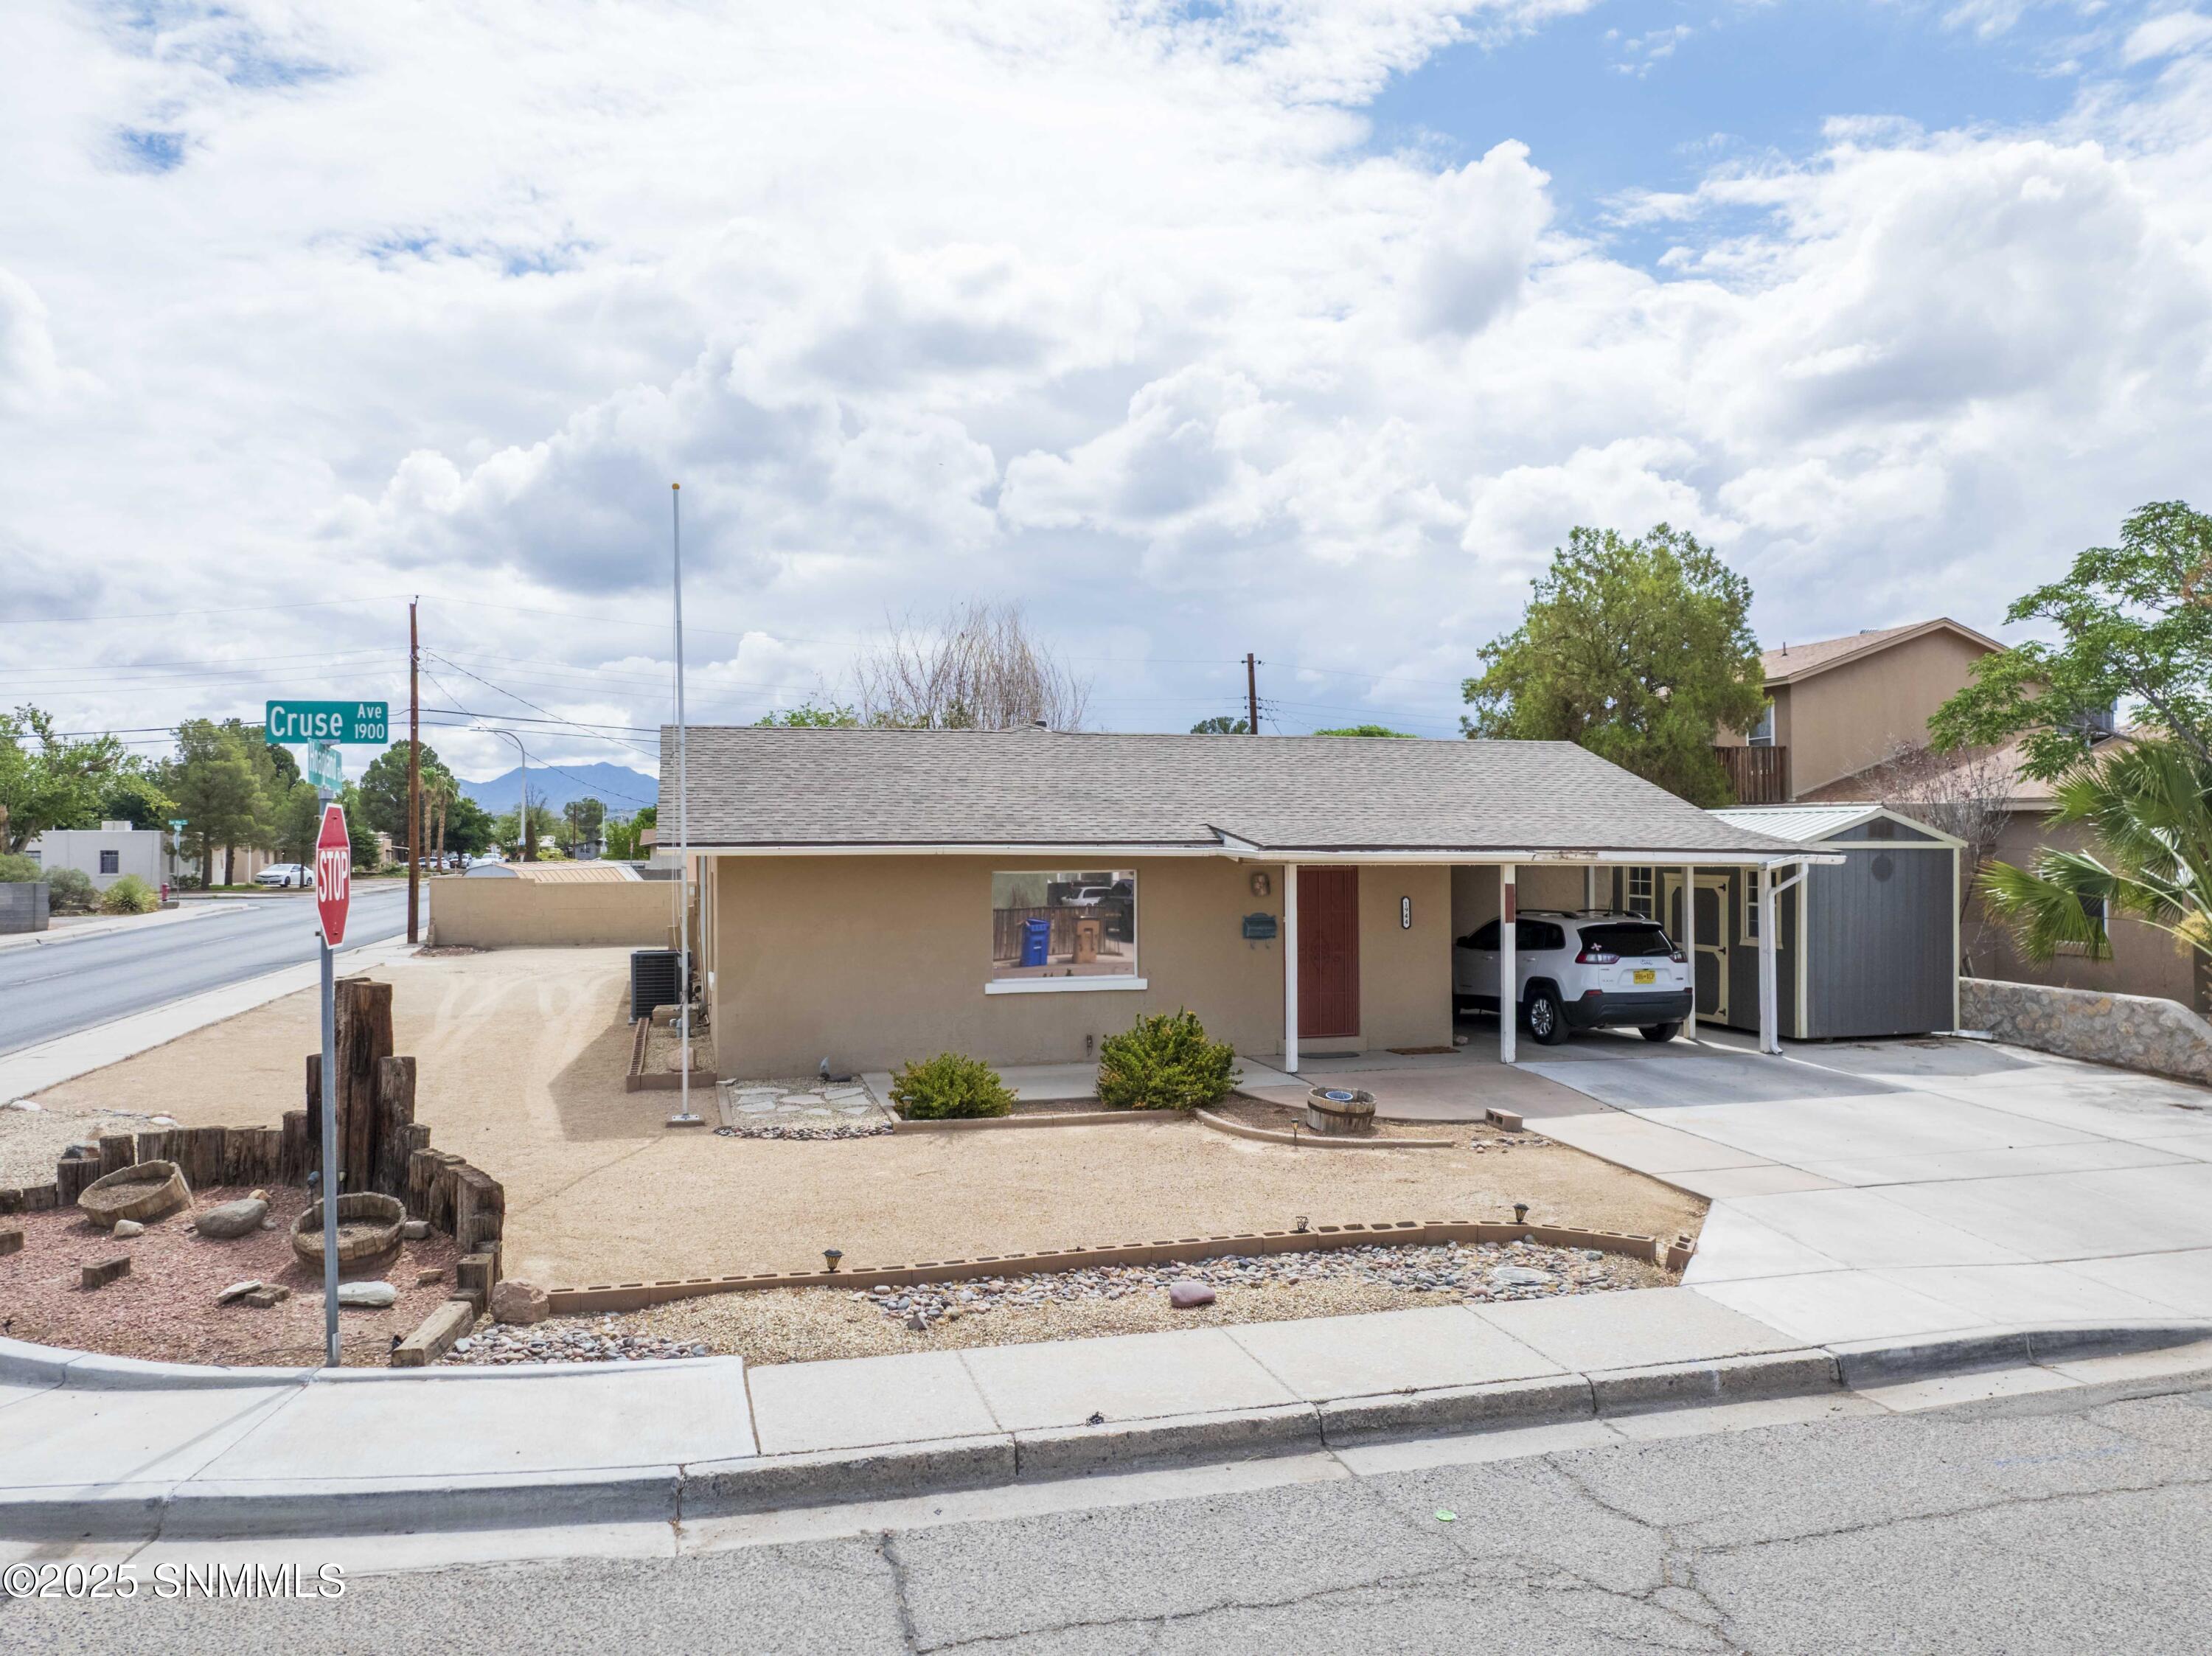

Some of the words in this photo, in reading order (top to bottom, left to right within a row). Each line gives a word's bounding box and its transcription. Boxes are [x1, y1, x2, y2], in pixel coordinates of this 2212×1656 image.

[270, 706, 344, 737] Cruse
[357, 703, 382, 719] Ave
[354, 723, 385, 739] 1900
[319, 849, 348, 902] STOP
